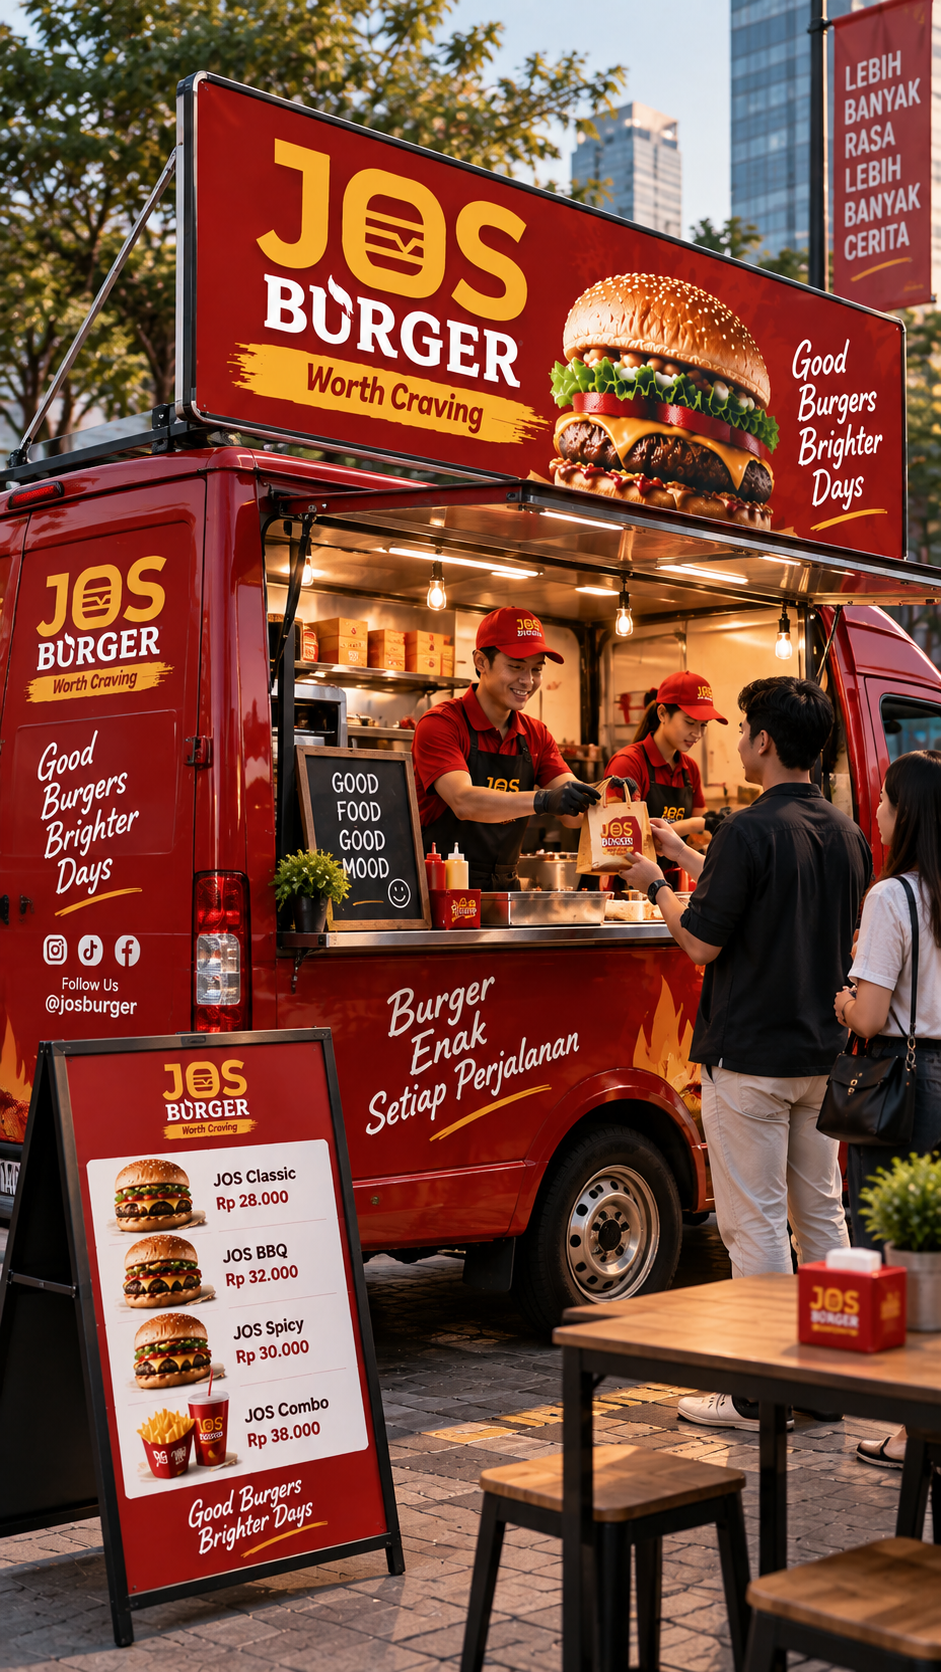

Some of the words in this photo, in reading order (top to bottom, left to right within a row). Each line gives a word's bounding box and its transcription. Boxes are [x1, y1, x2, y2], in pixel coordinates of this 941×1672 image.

[845, 50, 902, 92] LEBIH
[844, 77, 921, 126] BANYAK
[844, 121, 896, 159] RASA
[845, 154, 902, 194] LEBIH
[844, 183, 921, 228] BANYAK
[256, 138, 528, 321] JOS
[844, 221, 910, 261] CERITA
[264, 274, 520, 388] BURGER
[792, 338, 850, 381] Good
[307, 362, 385, 405] Worth
[391, 382, 484, 434] Craving
[797, 383, 877, 424] Burgers
[798, 424, 883, 470] Brighter
[812, 468, 864, 510] Days
[36, 555, 167, 637] JOS
[36, 626, 160, 671] BURGER
[53, 675, 87, 694] Worth
[90, 670, 137, 689] Craving
[37, 730, 98, 781] Good
[40, 772, 128, 820] Burgers
[332, 772, 379, 794] GOOD
[337, 801, 381, 822] FOOD
[44, 808, 140, 859] Brighter
[339, 830, 385, 851] GOOD
[56, 857, 113, 895] Days
[342, 857, 389, 879] MOOD
[62, 977, 100, 991] Follow
[103, 978, 119, 992] Us
[45, 995, 138, 1018] @josburger
[387, 976, 495, 1037] Burger
[410, 1010, 487, 1076] Enak
[162, 1059, 248, 1101] JOS
[365, 1082, 447, 1135] Setiap
[454, 1032, 579, 1100] Perjalanan
[165, 1098, 250, 1121] BURGER
[182, 1124, 206, 1135] Worth
[213, 1171, 243, 1187] JOS
[246, 1167, 296, 1184] Classic
[216, 1196, 236, 1213] Rp
[239, 1190, 289, 1208] 28.000
[223, 1248, 252, 1264] JOS
[256, 1243, 288, 1260] BBQ
[225, 1272, 245, 1290] Rp
[248, 1264, 299, 1284] 32.000
[811, 1286, 860, 1315] JOS
[233, 1323, 263, 1340] JOS
[266, 1318, 304, 1338] Spicy
[235, 1350, 256, 1366] Rp
[259, 1339, 309, 1360] 30.000
[244, 1406, 275, 1423] JOS
[278, 1397, 329, 1417] Combo
[247, 1432, 267, 1450] Rp
[270, 1421, 321, 1442] 38.000
[188, 1489, 234, 1528] Good
[239, 1479, 302, 1512] Burgers
[198, 1515, 269, 1554] Brighter
[273, 1502, 313, 1529] Days
